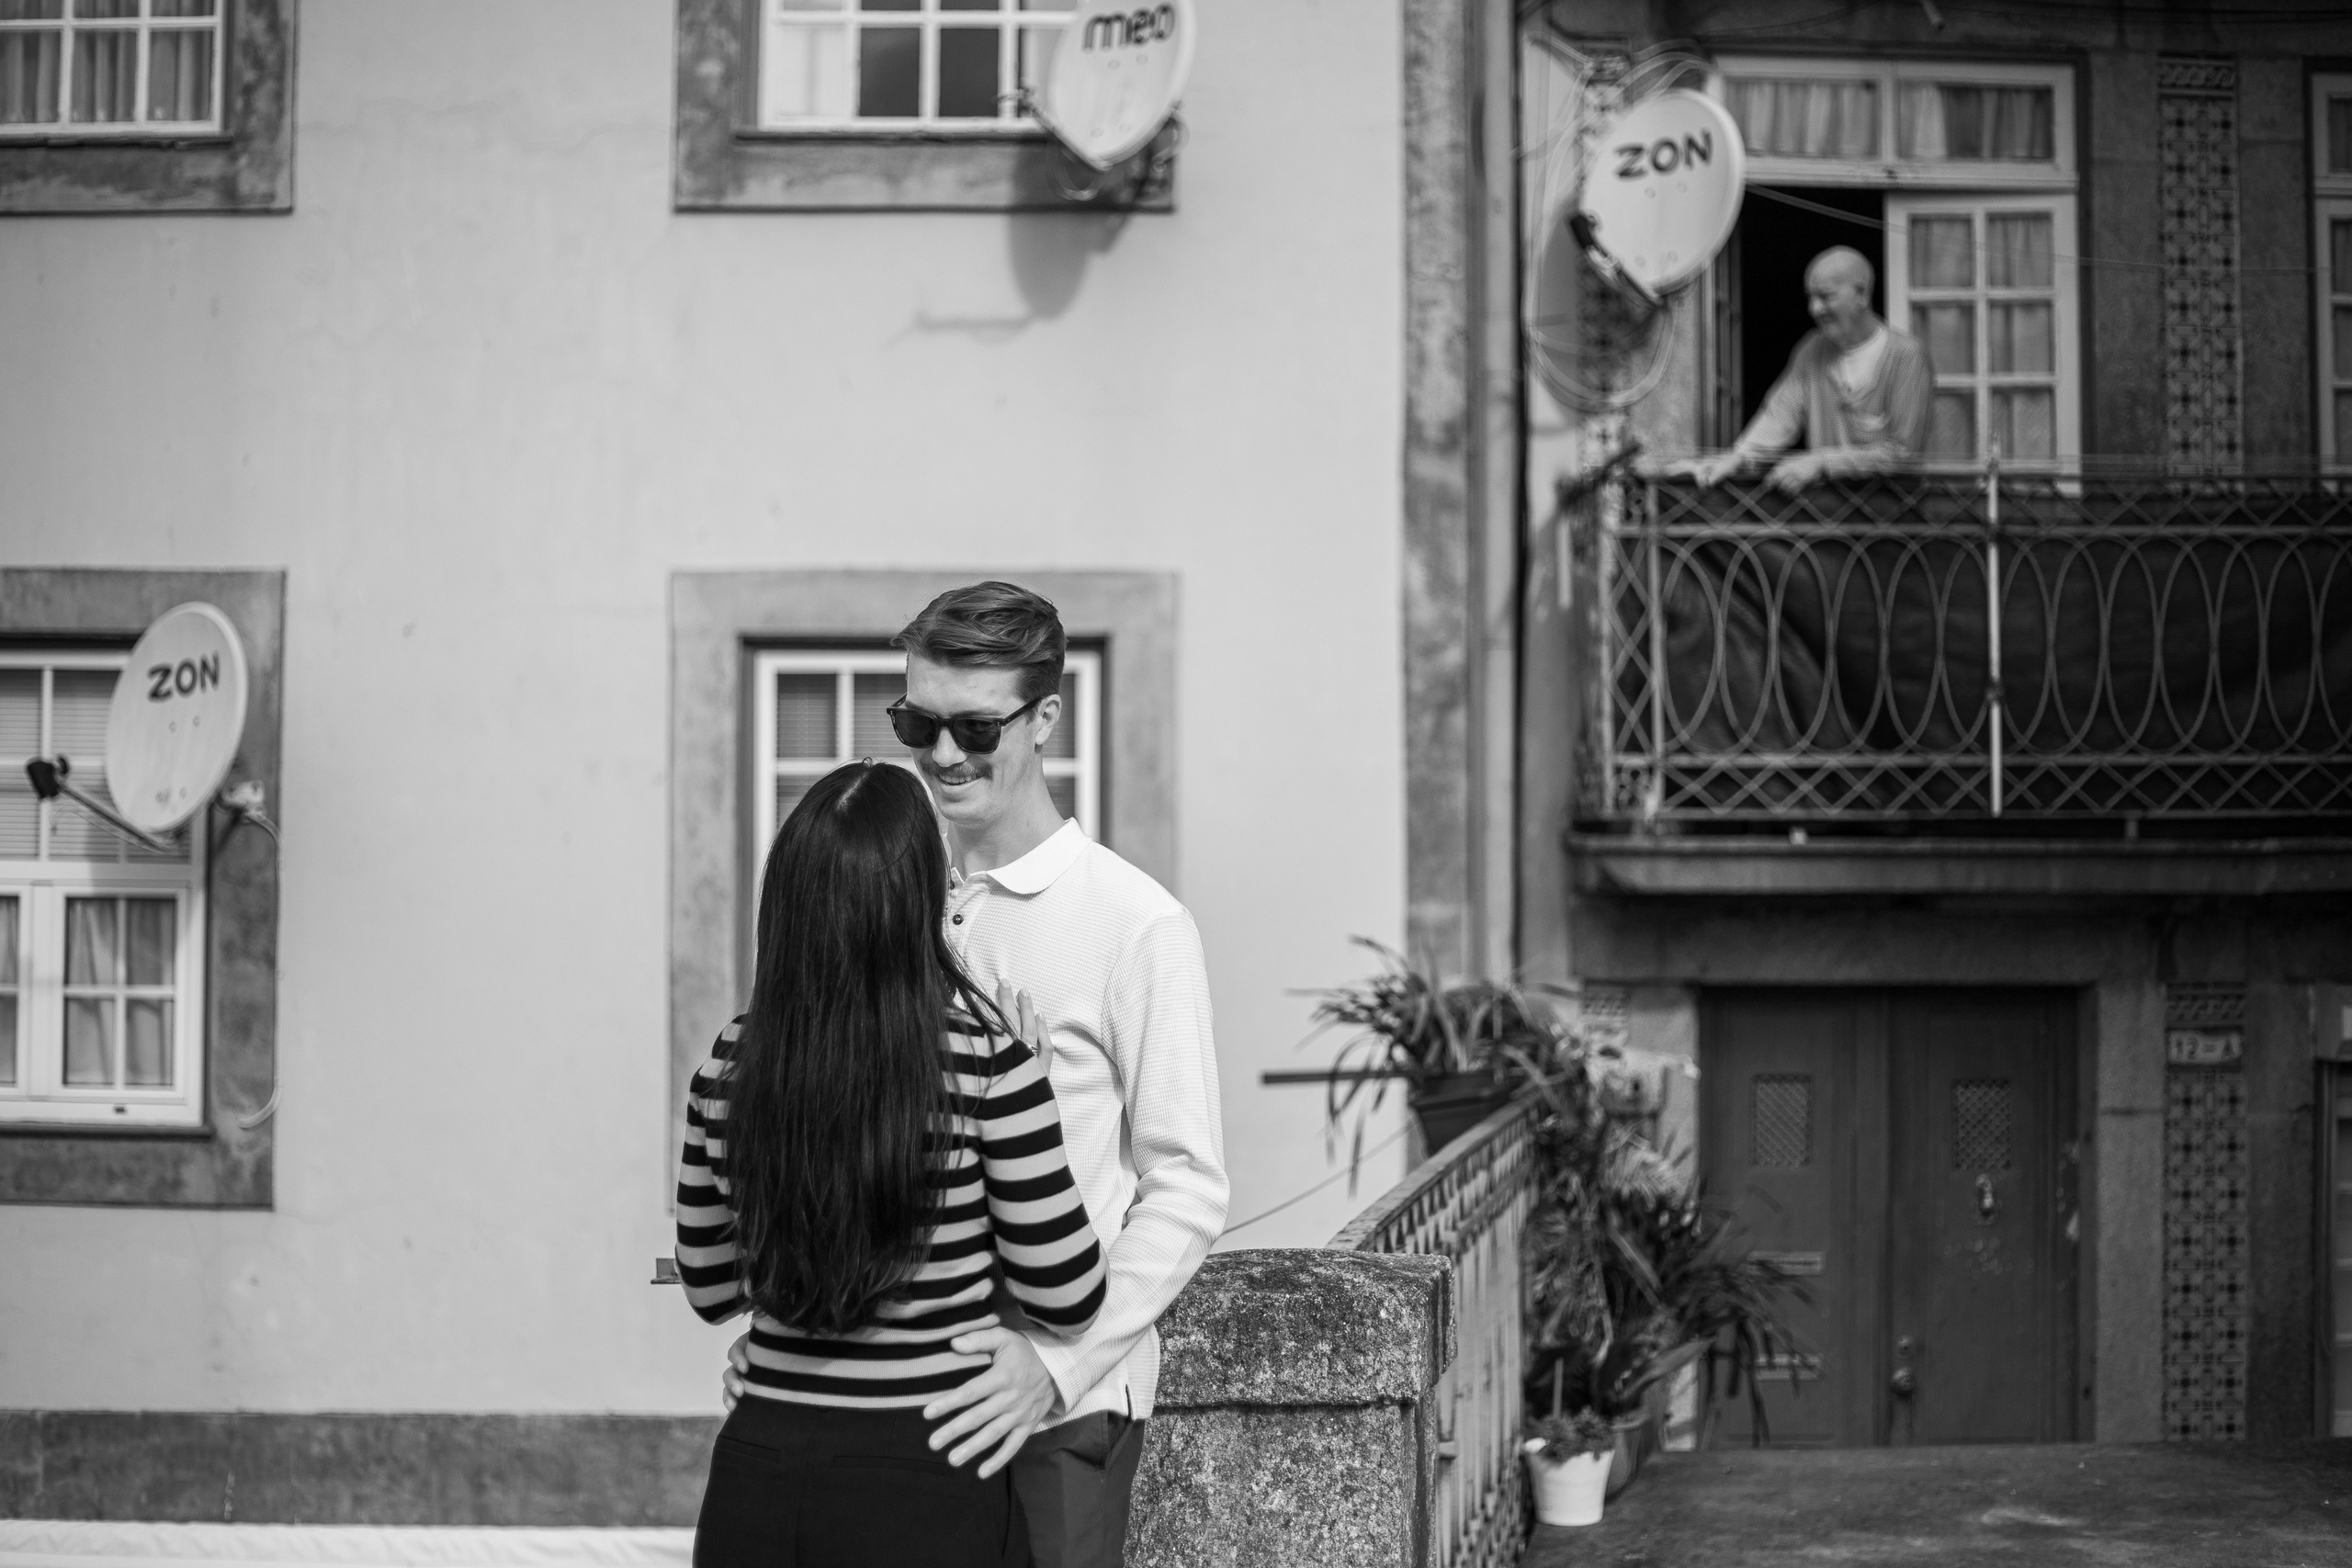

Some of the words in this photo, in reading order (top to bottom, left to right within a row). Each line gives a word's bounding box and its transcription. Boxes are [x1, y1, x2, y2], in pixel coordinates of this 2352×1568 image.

[1082, 4, 1175, 51] meo
[1614, 129, 1712, 179] ZON
[147, 652, 220, 701] ZON
